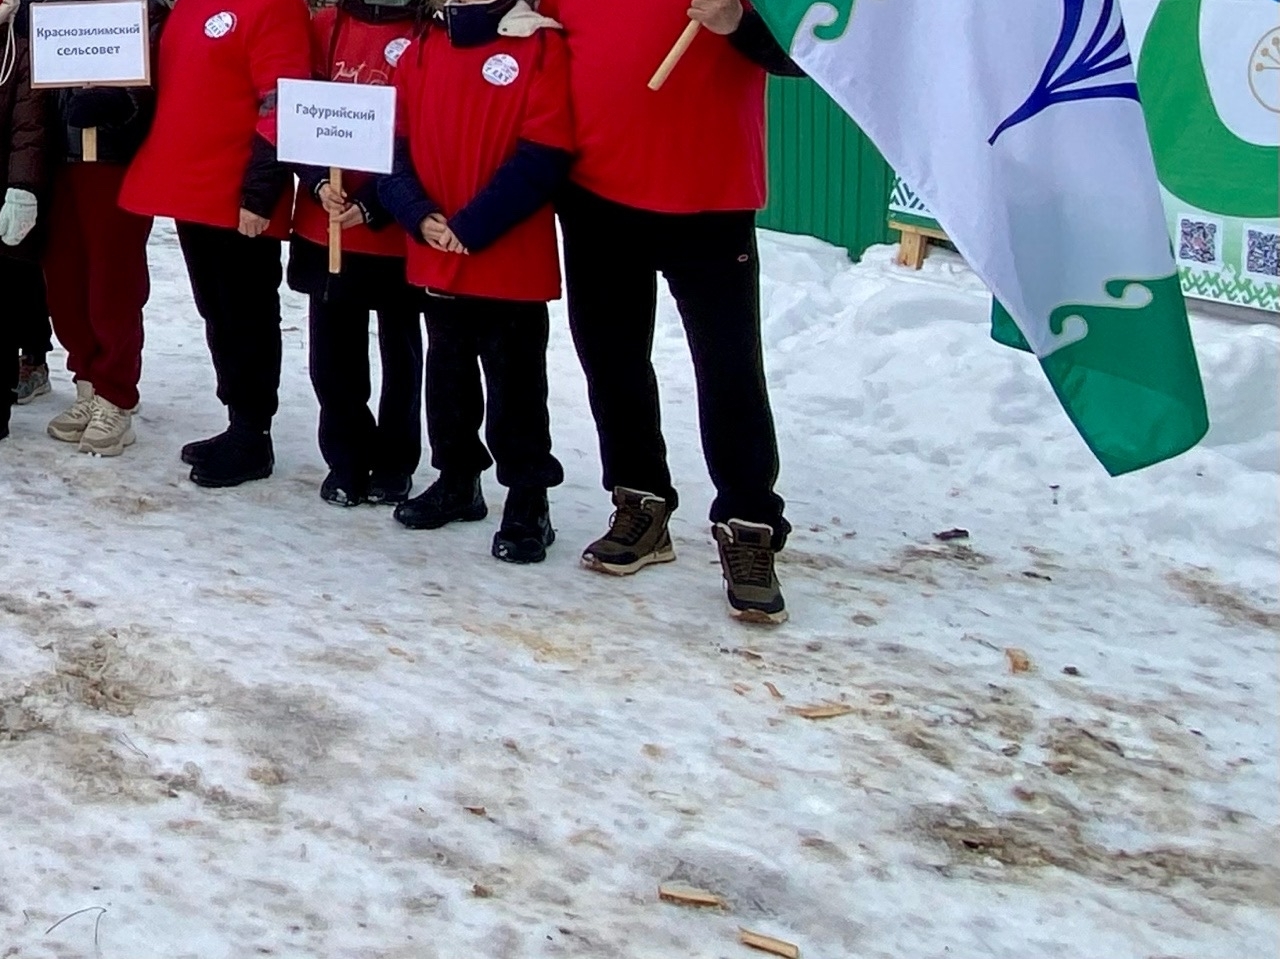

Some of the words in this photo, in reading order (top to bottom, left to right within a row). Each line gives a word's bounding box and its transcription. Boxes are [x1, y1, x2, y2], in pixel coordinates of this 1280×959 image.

[37, 24, 140, 40] Краснозилимский
[57, 45, 121, 56] сельсовет
[296, 103, 376, 121] Гафурийский
[316, 126, 353, 139] район
